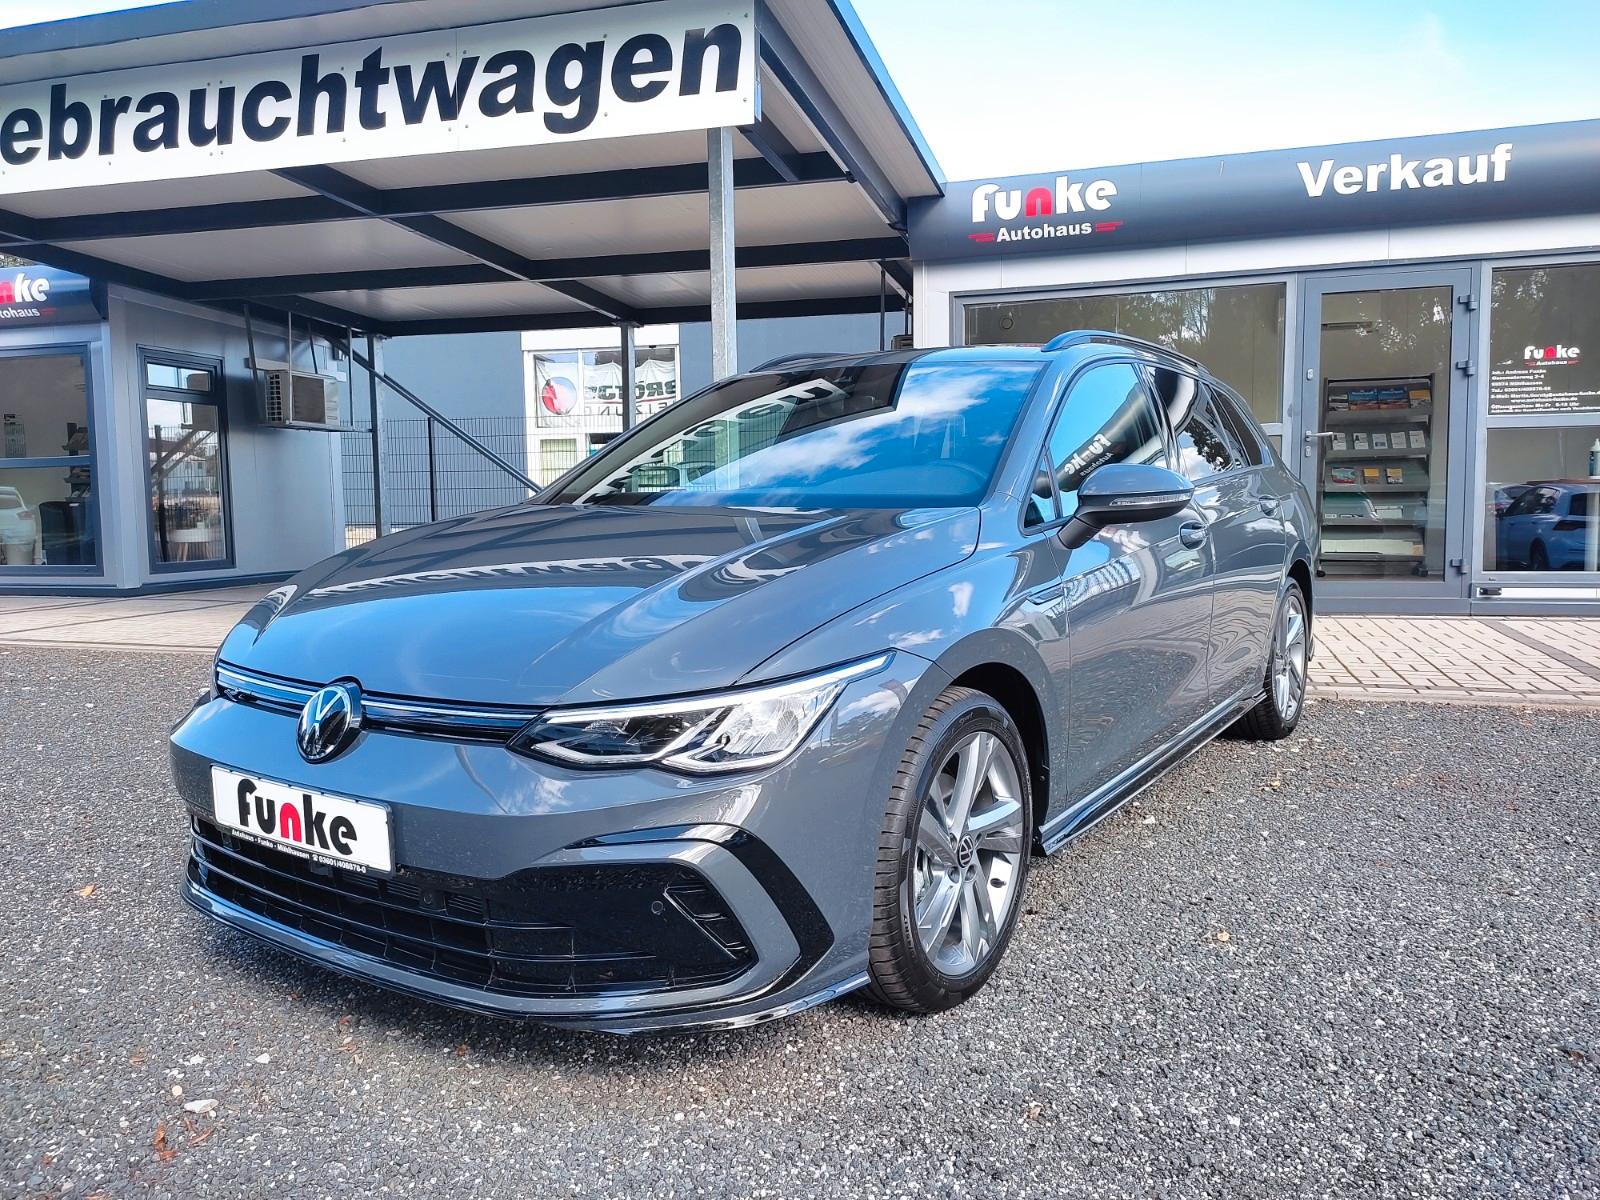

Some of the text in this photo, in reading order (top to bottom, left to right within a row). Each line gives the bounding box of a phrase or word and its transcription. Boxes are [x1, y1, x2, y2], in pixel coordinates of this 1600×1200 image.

[0, 23, 742, 166] ebrauchtwagen
[1296, 143, 1513, 198] Verkauf
[972, 175, 1118, 223] funke
[996, 222, 1093, 242] Autohaus
[1523, 344, 1581, 360] funke
[237, 778, 358, 856] funke
